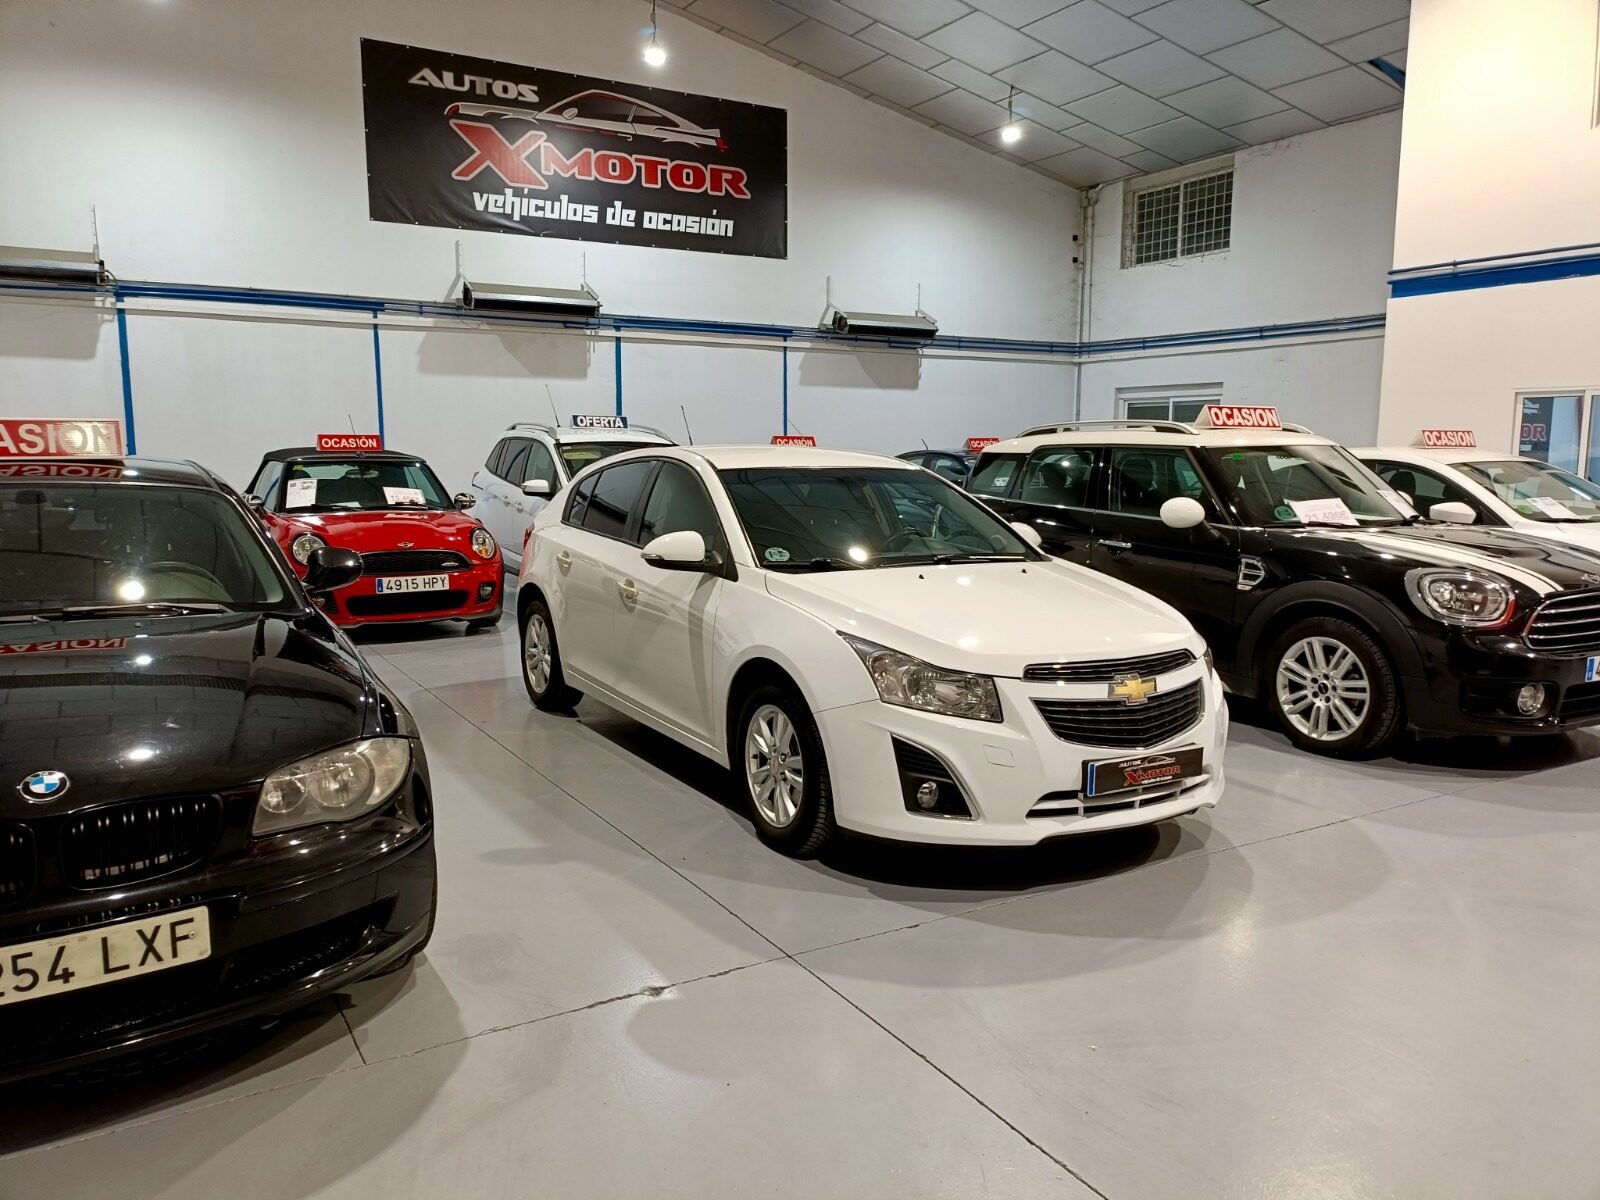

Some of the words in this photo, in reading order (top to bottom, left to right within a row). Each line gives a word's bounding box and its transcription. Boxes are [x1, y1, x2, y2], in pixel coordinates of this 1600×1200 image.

[408, 68, 539, 102] AUTOS
[472, 188, 599, 222] vehículos
[606, 200, 637, 227] de
[643, 209, 734, 238] ocasión
[576, 415, 624, 428] OFERTA
[1210, 407, 1279, 427] OCASION
[321, 436, 377, 448] OCASIÓN
[1423, 430, 1476, 446] OCASION
[386, 578, 419, 591] 4915
[423, 576, 447, 589] HPY
[0, 945, 76, 991] 54
[101, 917, 195, 974] LXF
